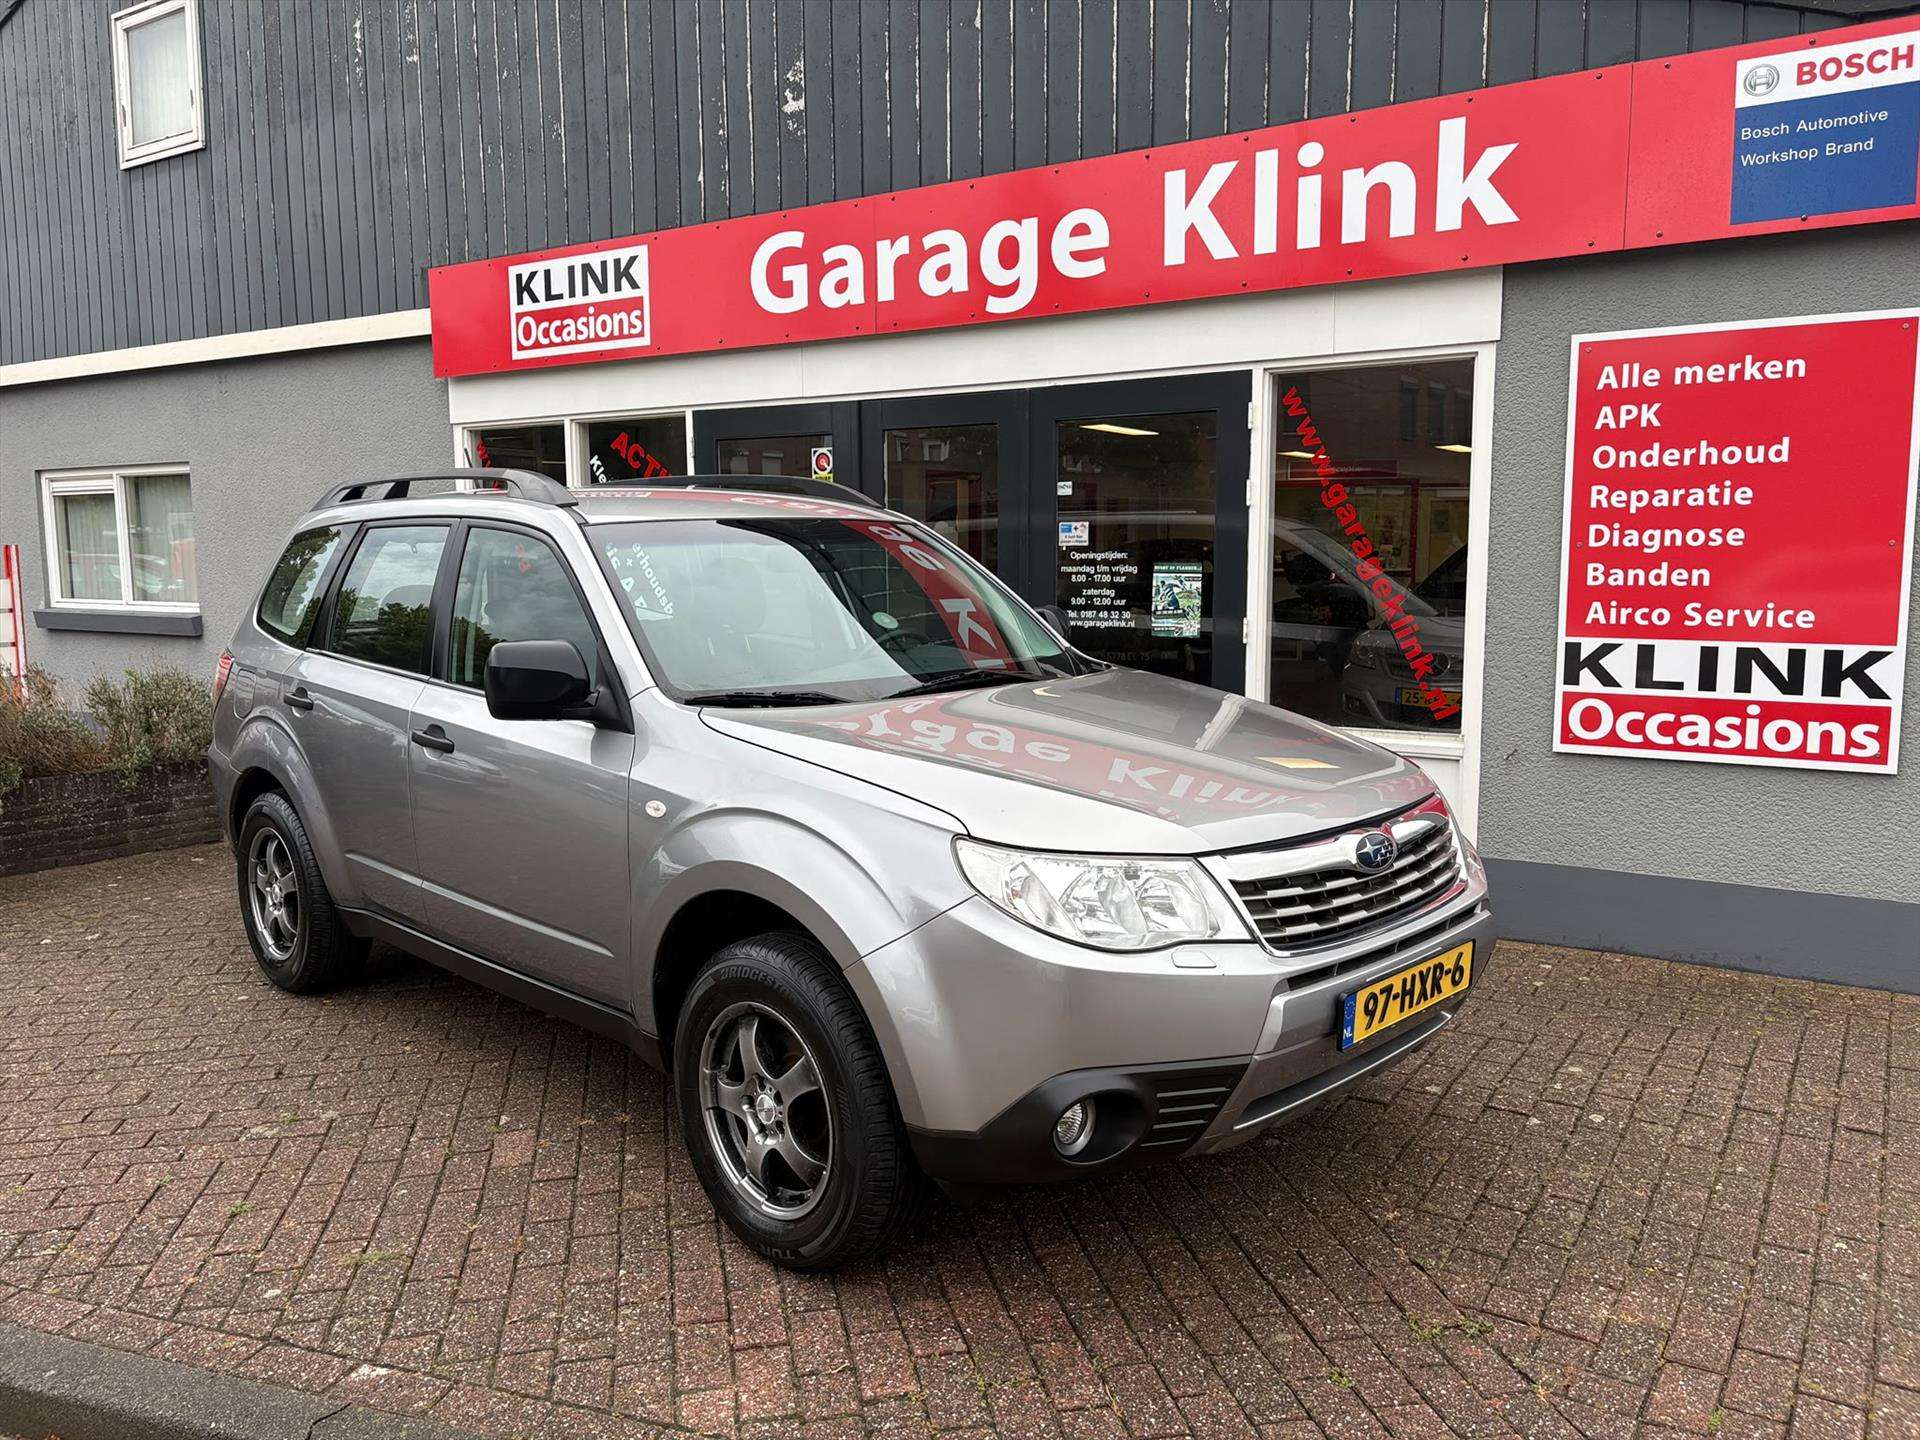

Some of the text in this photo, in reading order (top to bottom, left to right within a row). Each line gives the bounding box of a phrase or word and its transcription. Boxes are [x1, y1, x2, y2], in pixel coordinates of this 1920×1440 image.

[1796, 44, 1915, 86] BOSCH
[1741, 110, 1889, 141] Bosch Automotive
[1741, 137, 1874, 167] Workshop Brand
[750, 115, 1520, 315] Garage Klink
[515, 254, 641, 306] KLINK
[517, 306, 643, 347] Occasions
[1596, 355, 1807, 391] Alle merken
[1594, 402, 1662, 429] APK
[590, 454, 610, 484] Kle
[610, 431, 671, 479] ACT
[1592, 437, 1790, 470] Onderhoud
[1590, 480, 1754, 513] Reparatie
[1282, 386, 1460, 720] www.garageklink.nl
[1588, 523, 1745, 554] Diagnose
[1060, 564, 1095, 574] maandag
[1111, 564, 1138, 574] vrijdag
[1069, 551, 1128, 561] Openingstijden:
[632, 543, 673, 615] erhoudsb
[1071, 574, 1087, 583] 8.00
[1093, 574, 1112, 583] 17.00
[1113, 575, 1127, 583] uur
[1586, 563, 1711, 587] Banden
[1070, 597, 1086, 606] 9.00
[1093, 597, 1112, 606] 12.00
[1082, 588, 1116, 598] zaterdag
[1067, 610, 1131, 619] Tel. 0187 48 32 30
[1585, 601, 1816, 628] Airco Service
[1562, 641, 1894, 701] KLINK
[1567, 698, 1881, 758] Occasions
[1363, 952, 1465, 1031] 97-HXR-6
[1343, 1025, 1353, 1039] NL
